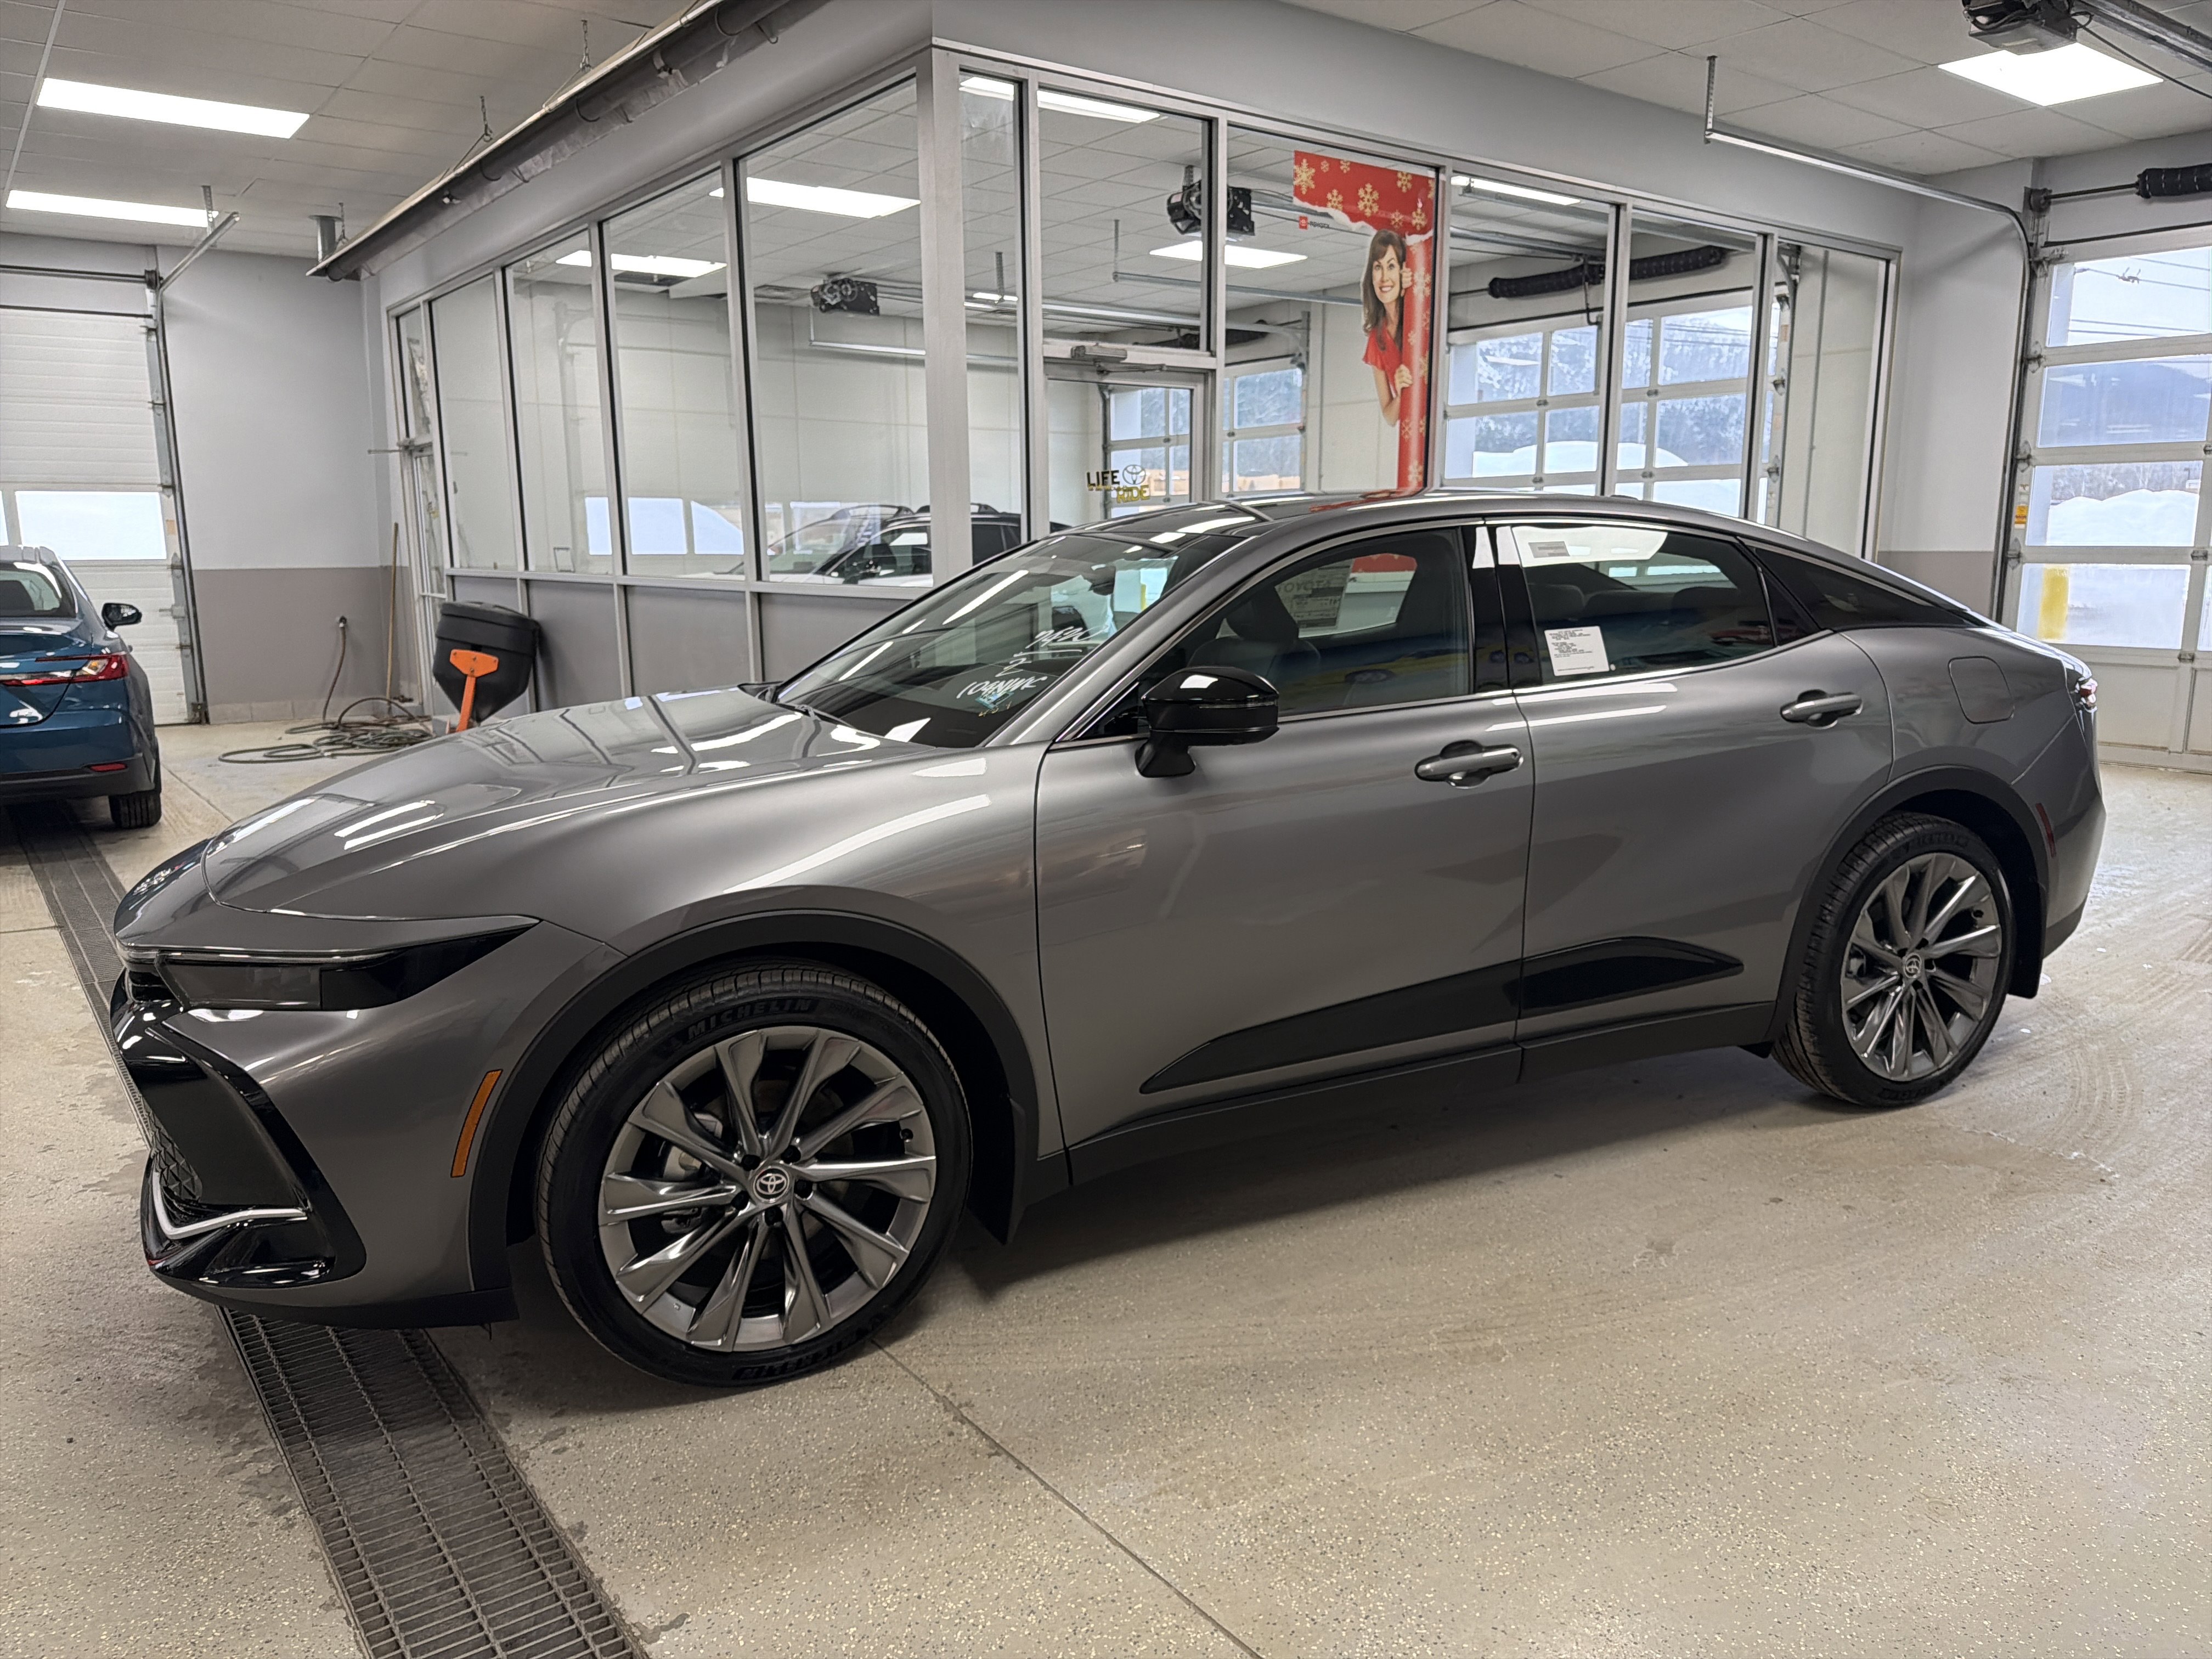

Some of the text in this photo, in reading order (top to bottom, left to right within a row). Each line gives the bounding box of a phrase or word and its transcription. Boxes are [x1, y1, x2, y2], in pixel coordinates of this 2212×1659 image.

[1086, 470, 1120, 487] LIFE
[1116, 484, 1150, 504] RIDE
[687, 997, 812, 1040] MICHELIN
